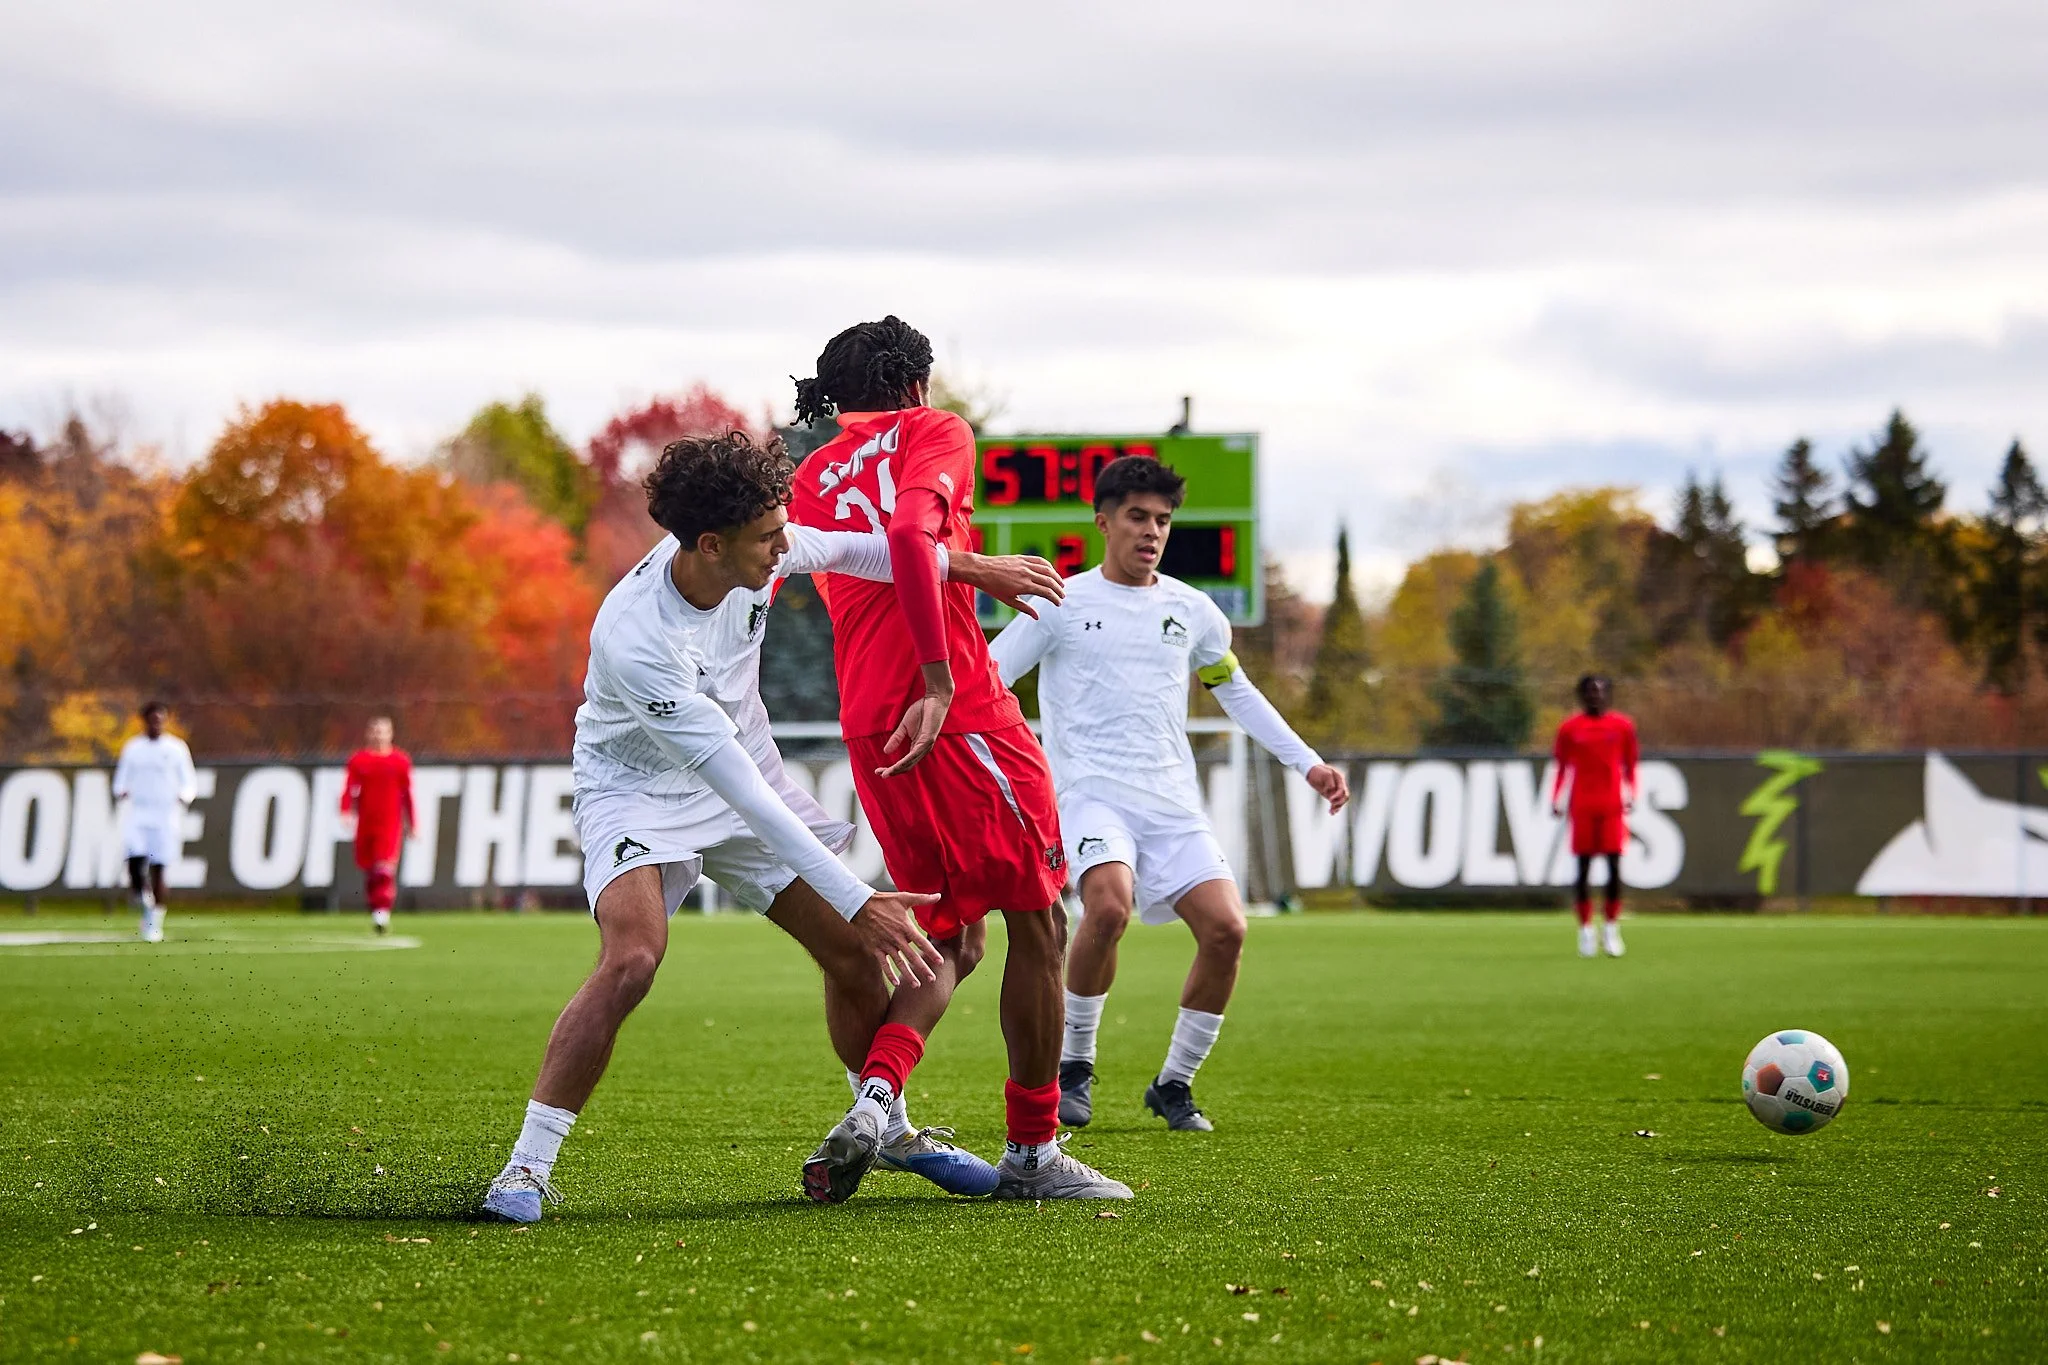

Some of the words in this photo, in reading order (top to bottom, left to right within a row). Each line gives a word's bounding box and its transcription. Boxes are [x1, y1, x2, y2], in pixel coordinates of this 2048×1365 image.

[983, 444, 1155, 505] 57:0
[1054, 537, 1084, 580] 2
[1220, 527, 1235, 577] 1
[402, 764, 583, 888] THE
[1284, 760, 1689, 889] WOLVS
